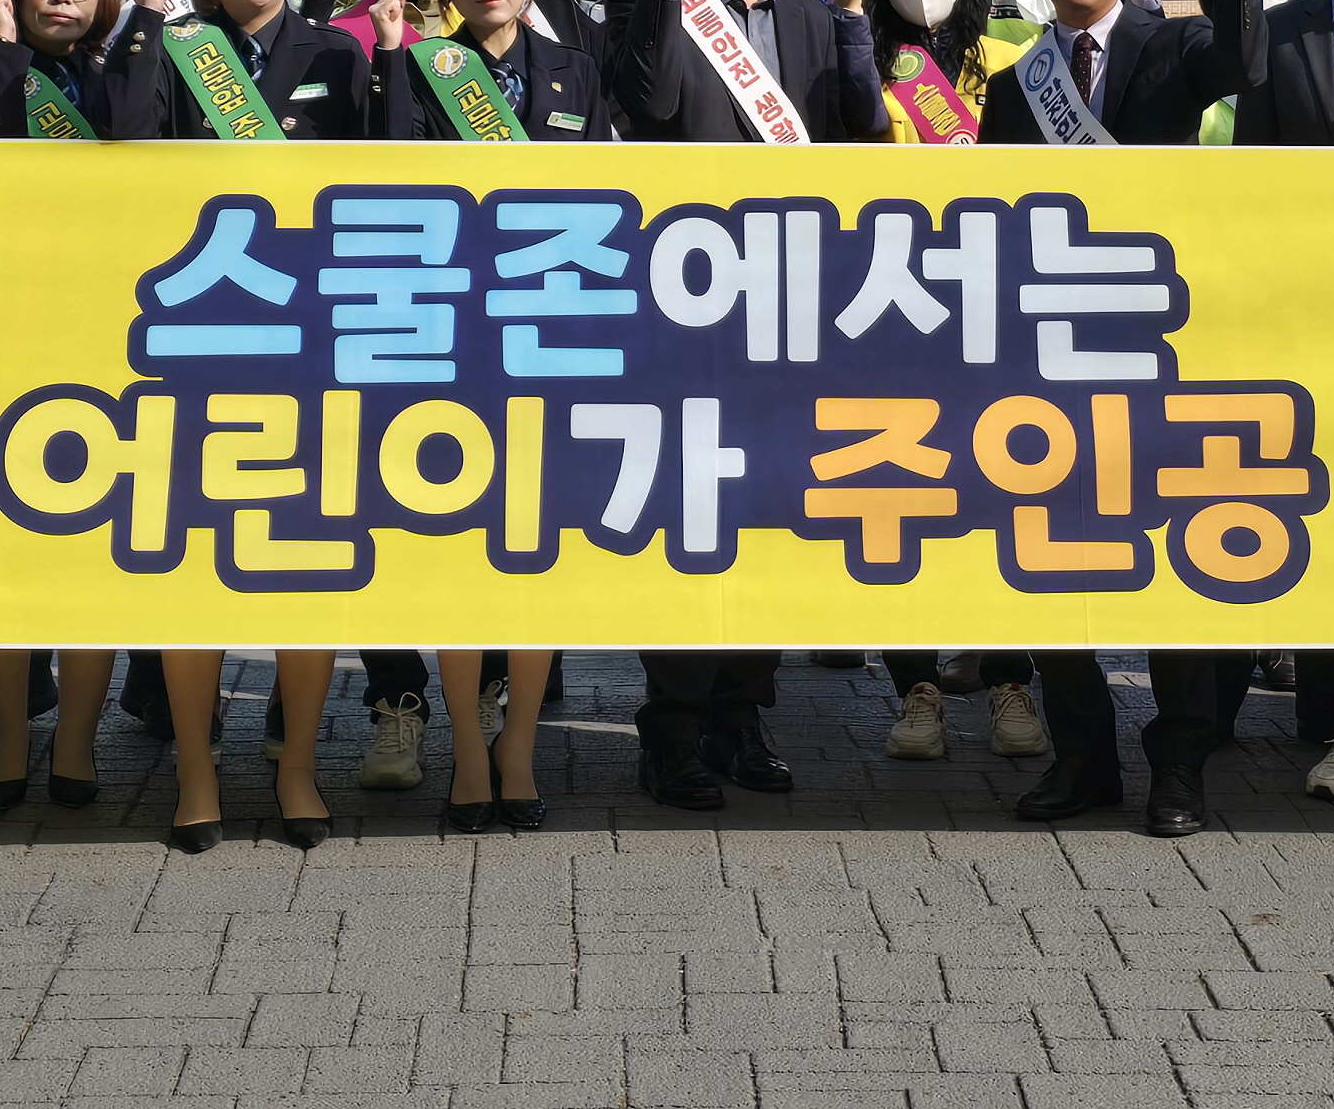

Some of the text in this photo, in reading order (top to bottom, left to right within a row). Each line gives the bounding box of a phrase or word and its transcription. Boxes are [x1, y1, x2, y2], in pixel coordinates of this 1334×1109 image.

[146, 198, 1169, 383] 스쿨존에서는
[4, 390, 1309, 583] 어린이가 주인공
